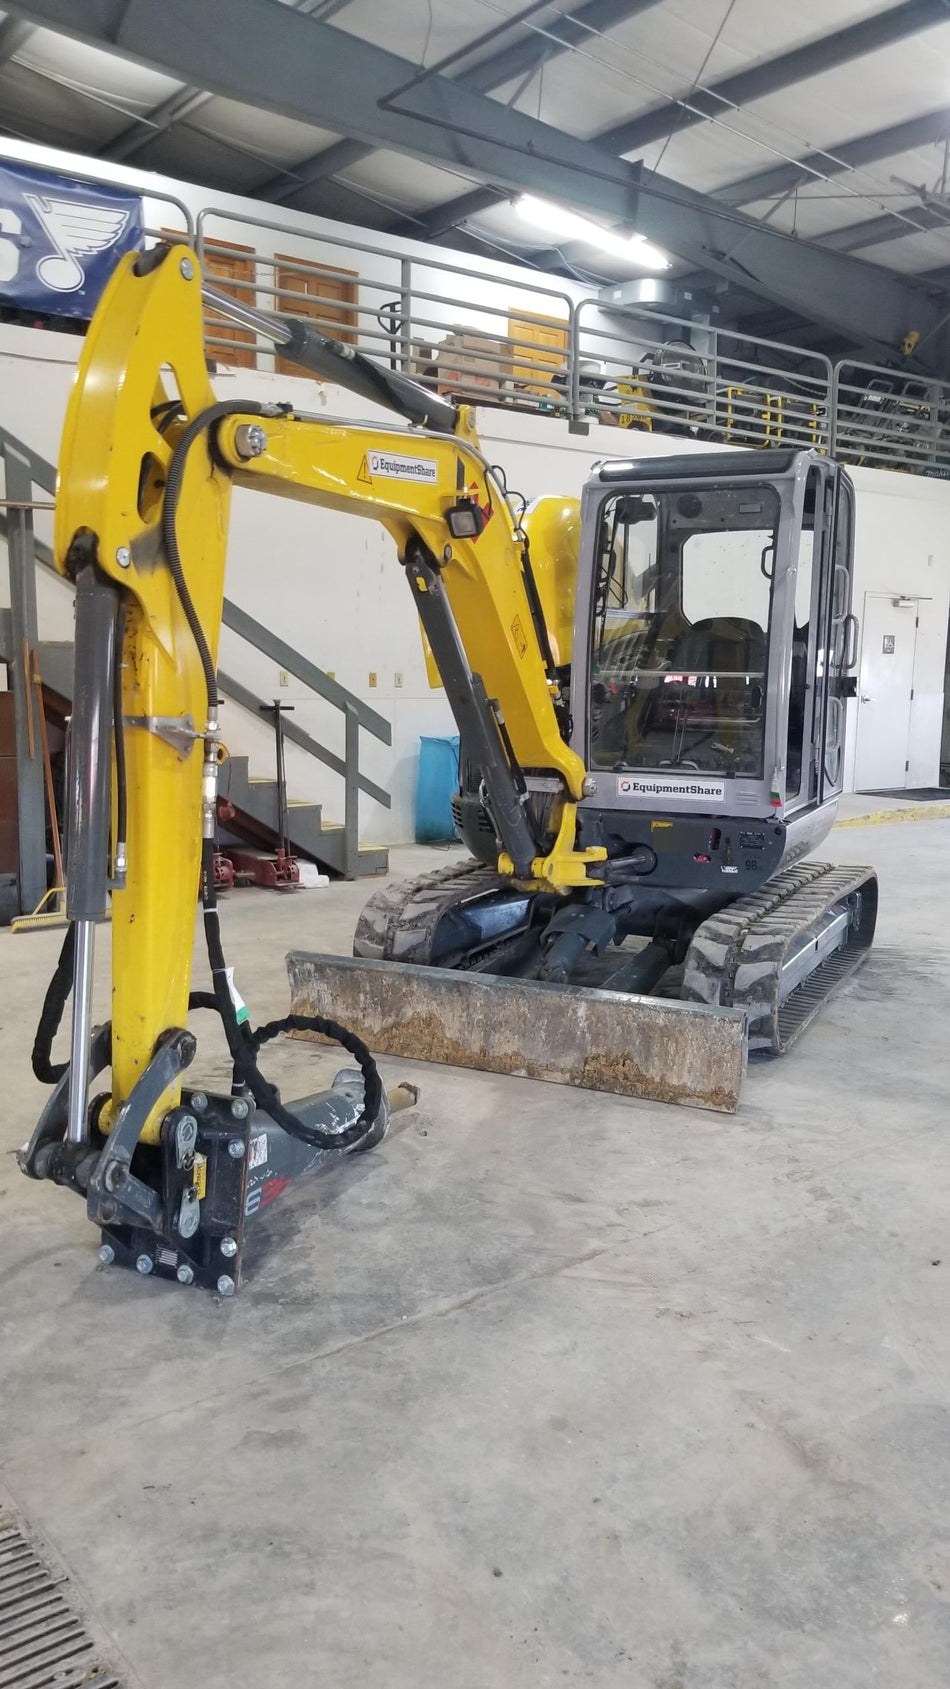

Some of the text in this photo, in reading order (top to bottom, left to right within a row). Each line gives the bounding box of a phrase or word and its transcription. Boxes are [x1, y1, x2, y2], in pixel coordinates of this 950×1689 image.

[380, 458, 435, 477] EquipmentShare
[632, 782, 722, 796] EquipmentShare
[745, 859, 758, 871] 98
